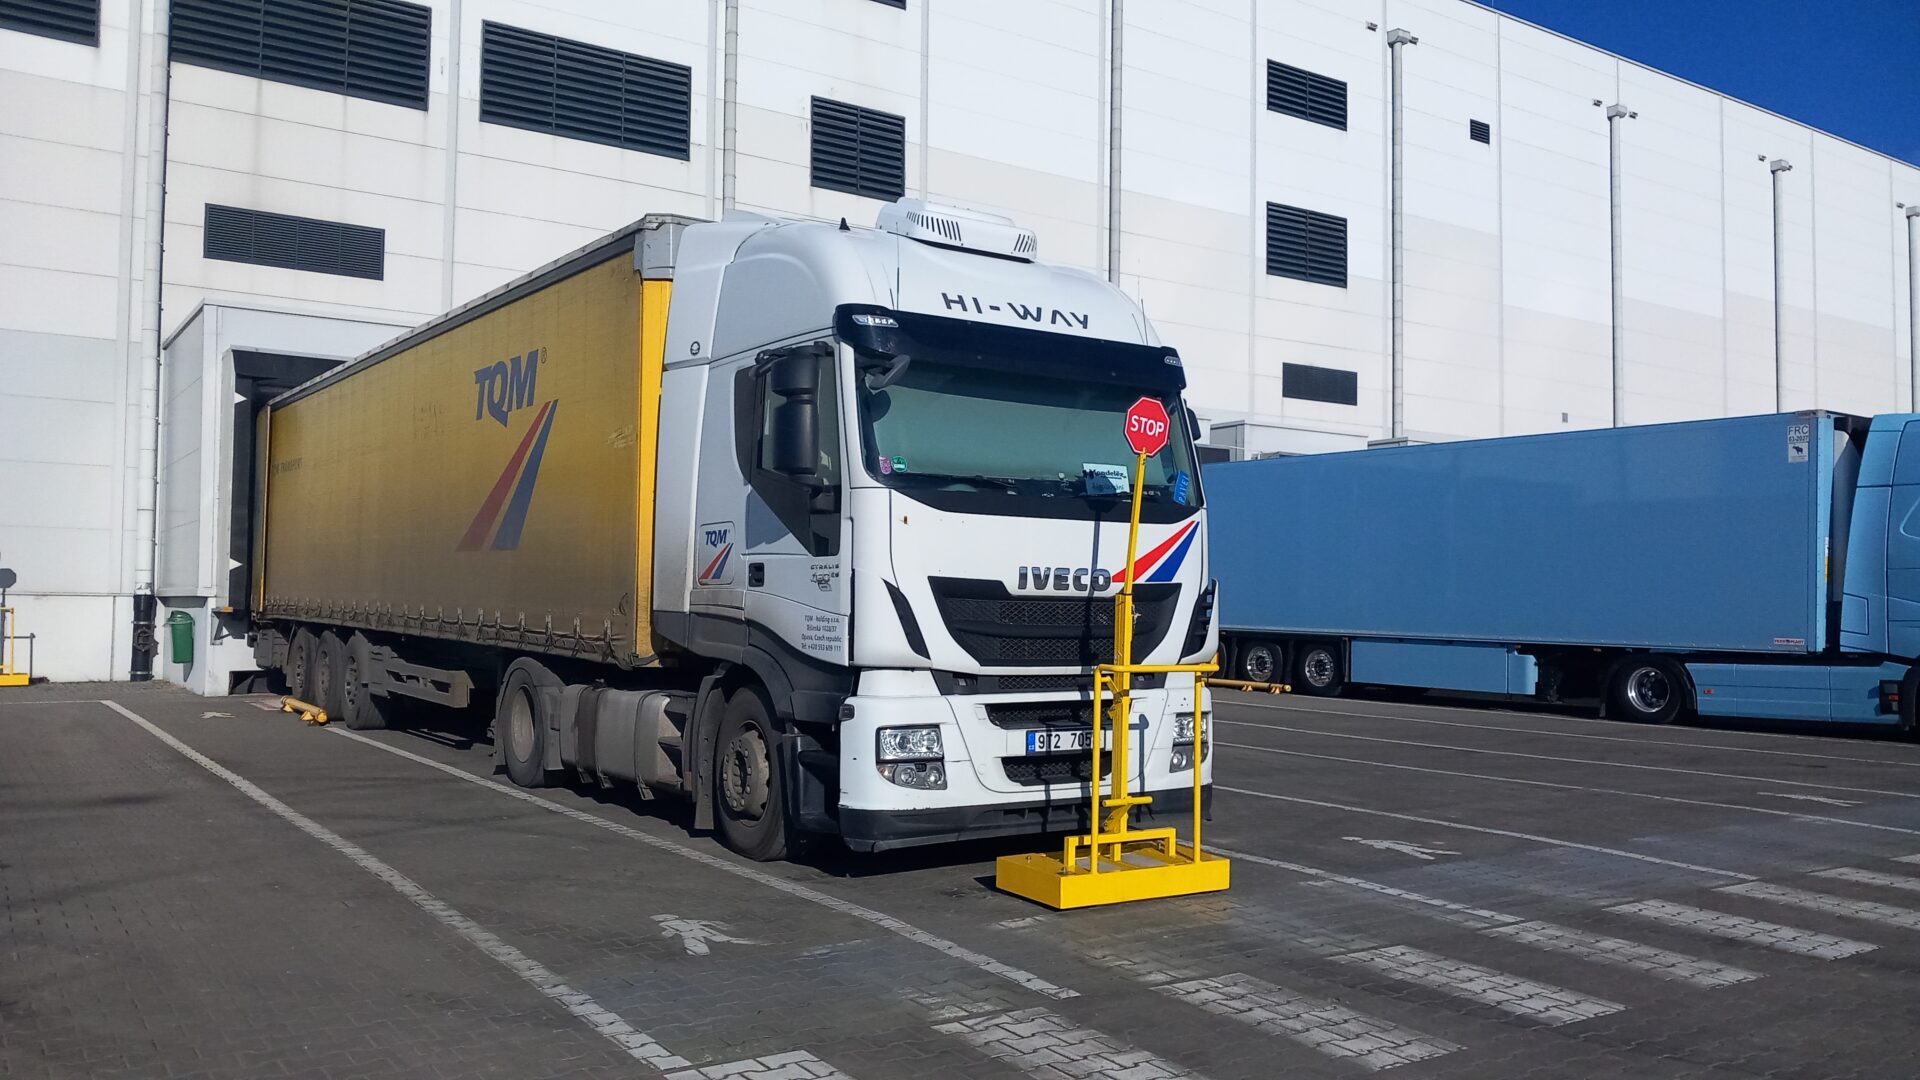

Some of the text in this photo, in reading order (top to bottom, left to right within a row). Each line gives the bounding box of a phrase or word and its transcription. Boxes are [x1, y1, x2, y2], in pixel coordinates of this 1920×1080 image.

[941, 292, 1088, 329] HI-WAY
[474, 349, 539, 428] TQM
[1130, 415, 1165, 437] STOP
[1788, 425, 1808, 435] FRC
[705, 529, 727, 548] TQM
[1018, 566, 1111, 592] IVECO
[1038, 733, 1061, 749] 9T2
[1070, 732, 1095, 748] 705
